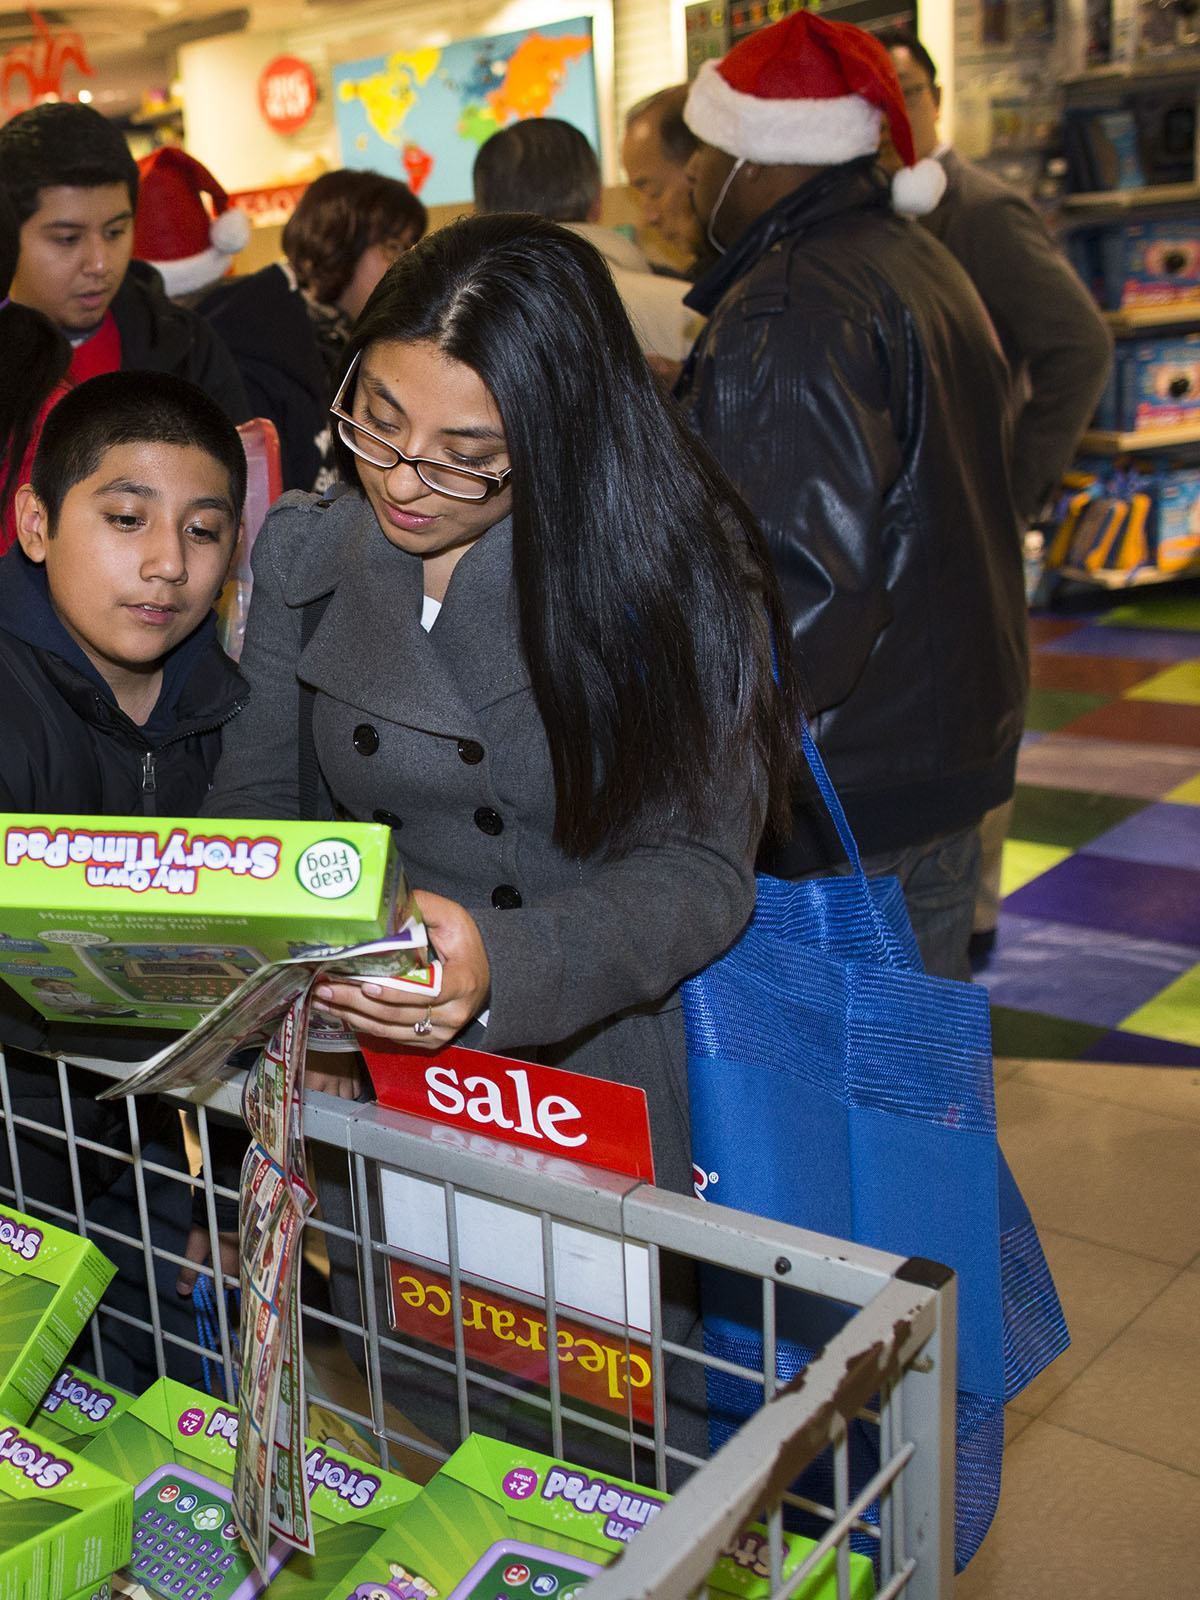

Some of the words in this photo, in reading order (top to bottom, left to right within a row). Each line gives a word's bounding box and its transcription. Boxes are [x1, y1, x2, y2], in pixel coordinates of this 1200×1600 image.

[305, 848, 349, 872] Frog
[86, 865, 152, 892] Own
[150, 864, 197, 894] My
[311, 866, 353, 889] Leap
[424, 1064, 589, 1148] sale
[182, 1418, 199, 1433] 2+
[187, 1410, 202, 1421] years
[508, 1478, 530, 1496] 2+
[512, 1469, 533, 1483] years
